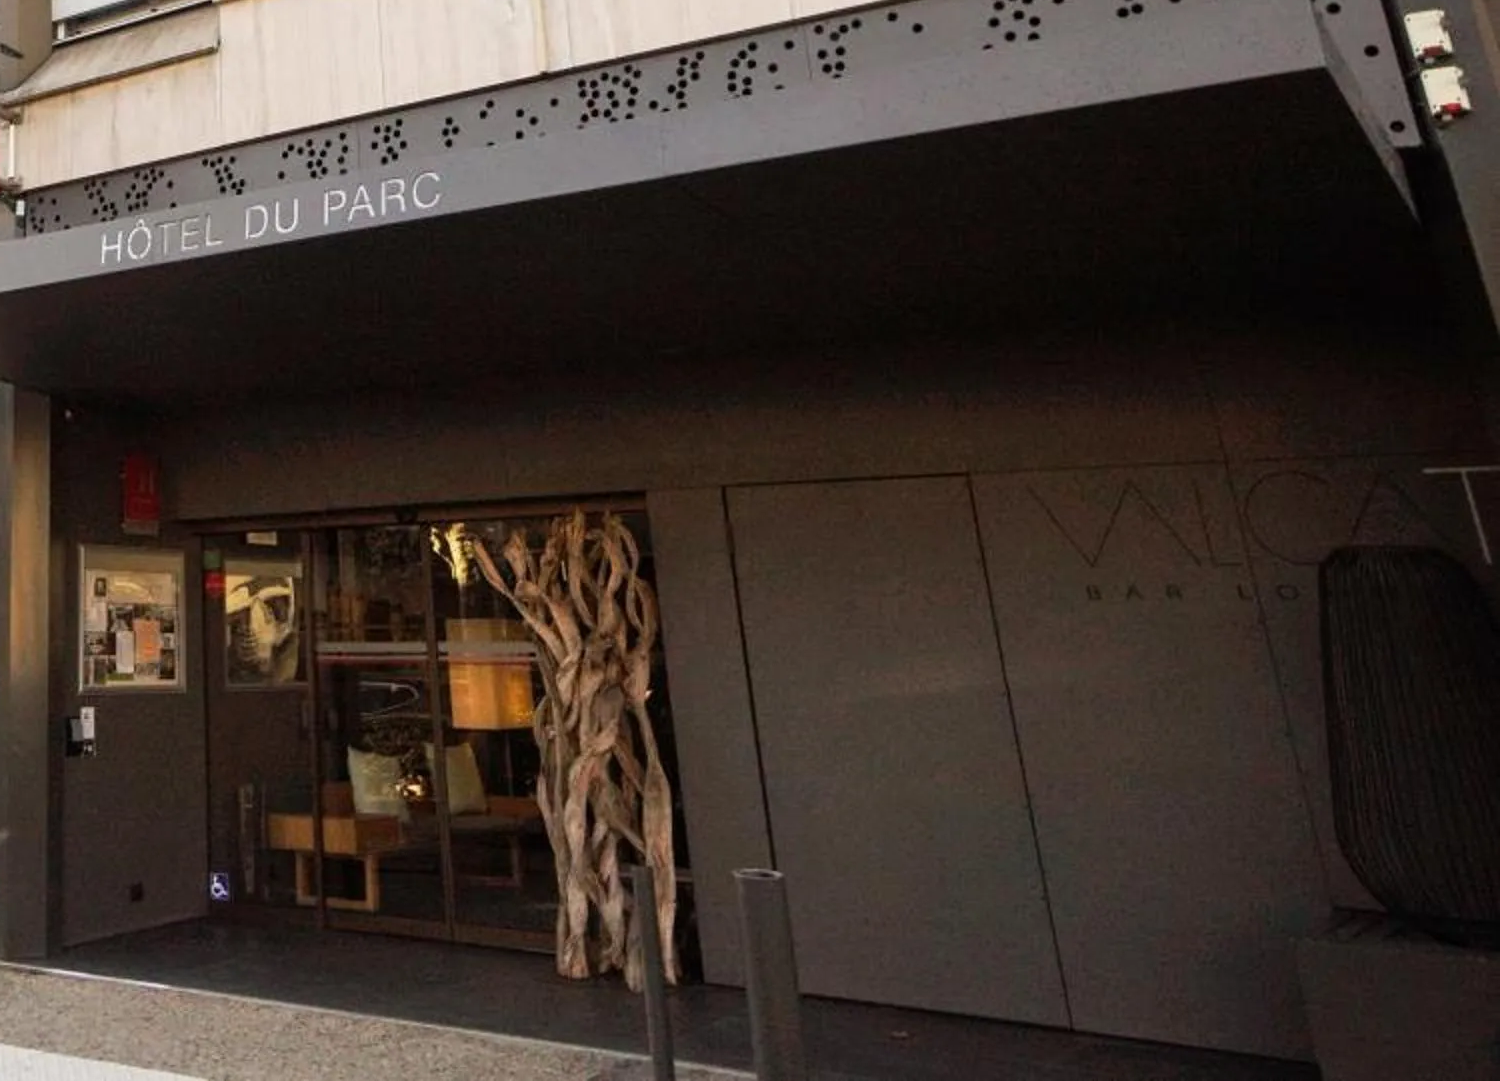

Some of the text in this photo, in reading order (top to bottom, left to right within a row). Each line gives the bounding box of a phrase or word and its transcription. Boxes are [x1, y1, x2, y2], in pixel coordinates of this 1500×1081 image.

[100, 172, 442, 265] HÔTEL DU PARC
